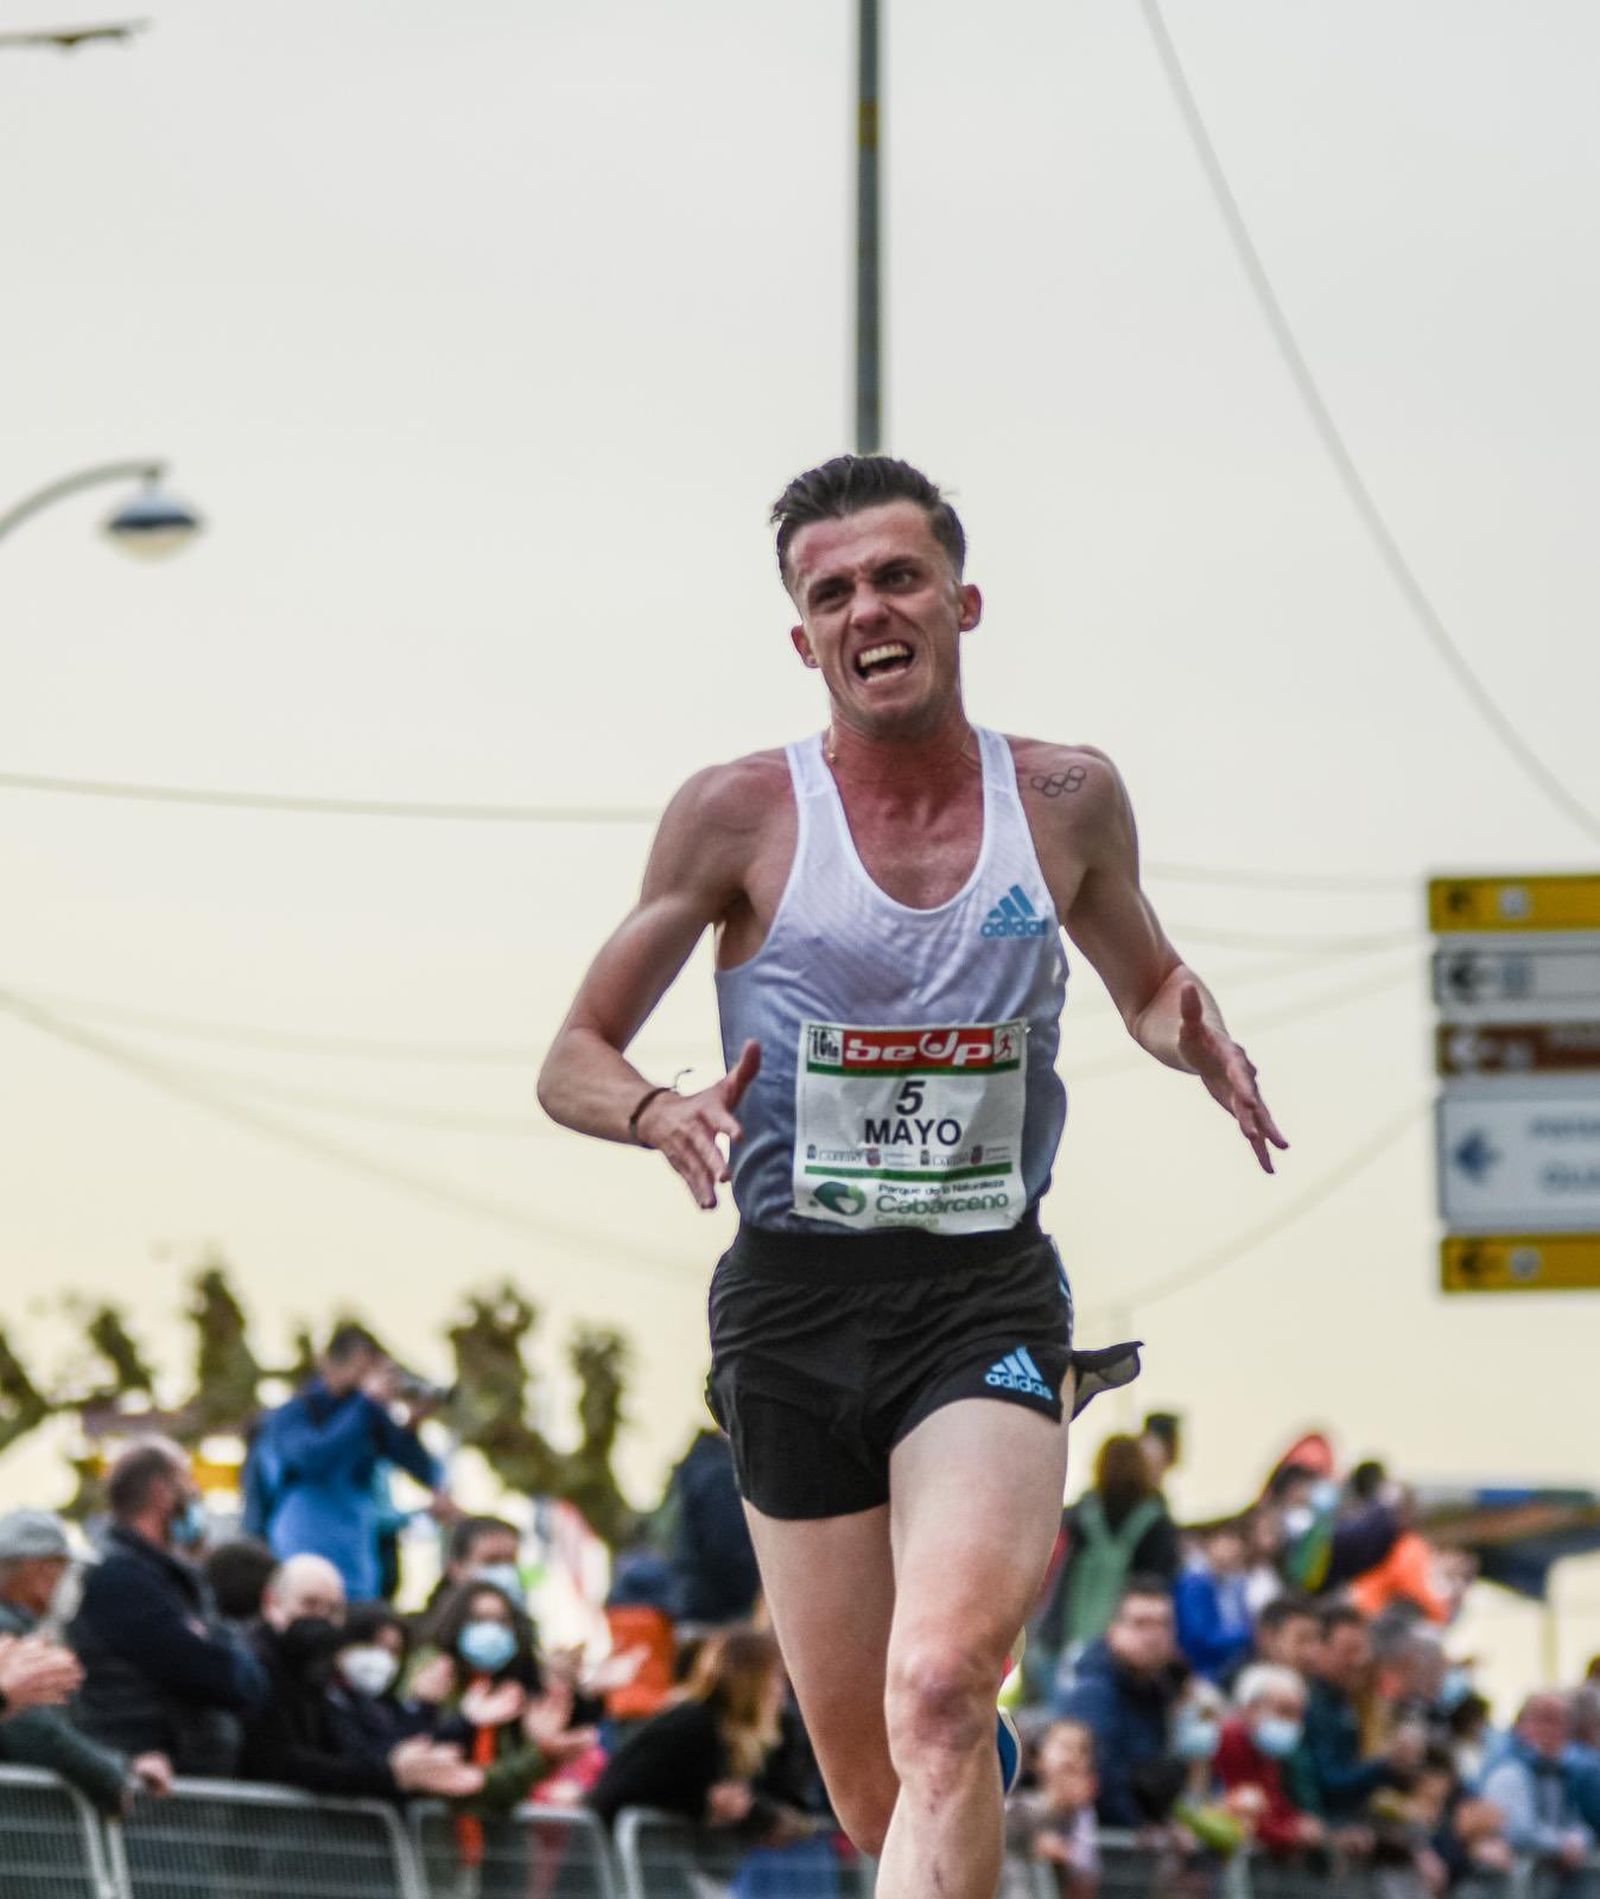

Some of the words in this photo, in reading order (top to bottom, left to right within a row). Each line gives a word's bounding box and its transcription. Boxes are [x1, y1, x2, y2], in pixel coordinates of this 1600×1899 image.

[896, 1081, 926, 1115] 5
[865, 1119, 961, 1146] MAYO
[984, 1372, 1054, 1401] adidas
